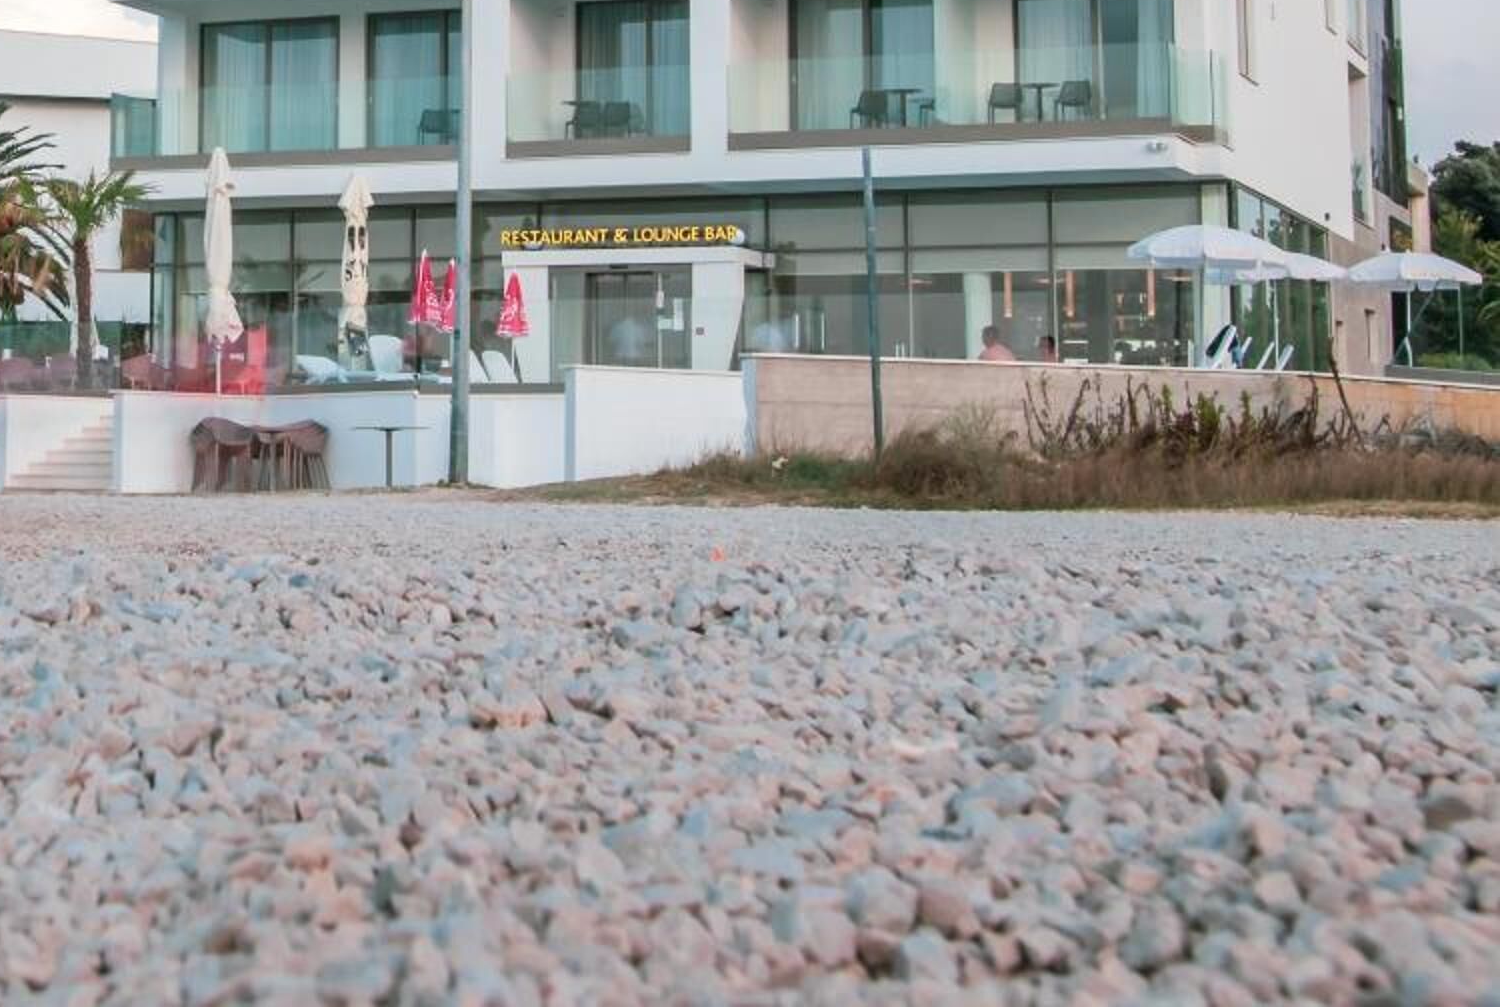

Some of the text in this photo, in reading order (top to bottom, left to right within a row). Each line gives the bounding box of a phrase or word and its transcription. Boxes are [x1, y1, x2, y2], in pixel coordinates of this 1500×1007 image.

[501, 224, 738, 246] RESTAURANT & LOUNGE BAR
